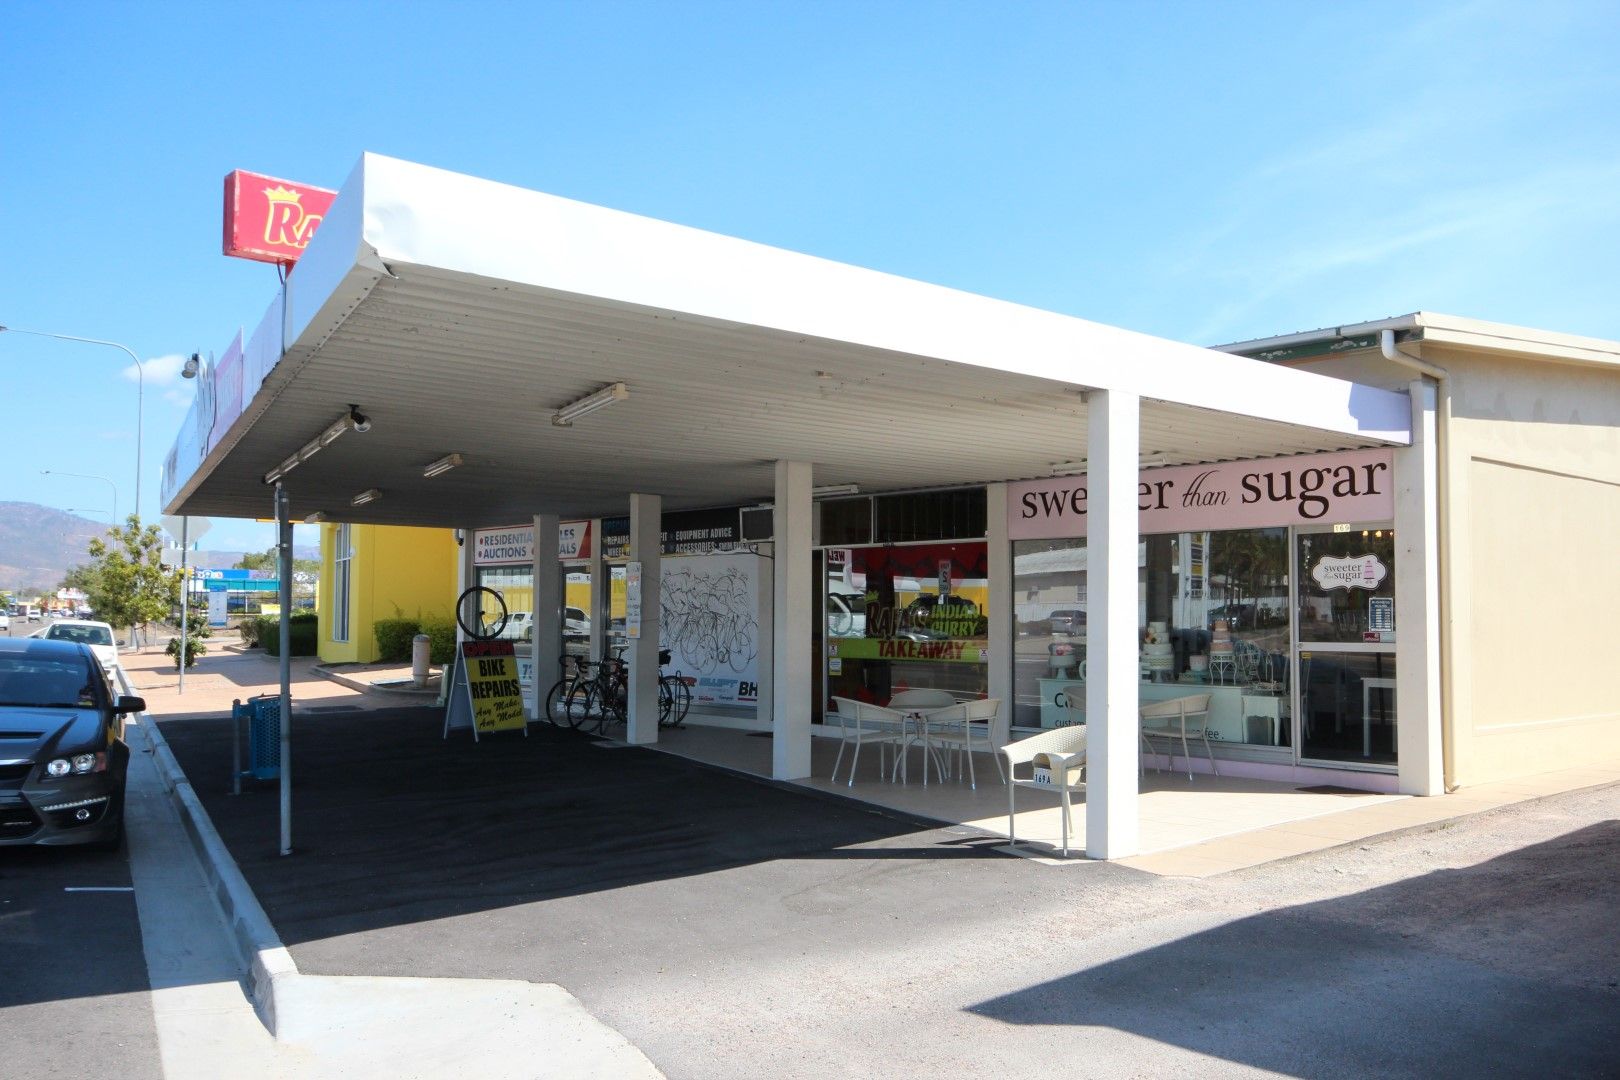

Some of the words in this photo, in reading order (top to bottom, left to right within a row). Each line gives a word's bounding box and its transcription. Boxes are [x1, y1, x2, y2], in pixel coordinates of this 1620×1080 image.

[1022, 481, 1173, 520] sweer
[1181, 470, 1230, 508] than
[1241, 463, 1387, 519] sugar
[484, 533, 534, 546] RESIDENTIA
[676, 529, 709, 541] EQUIPMENT
[711, 527, 732, 538] ADVICE
[483, 546, 527, 559] AUCTIONS
[1324, 564, 1362, 573] sweeter
[1334, 572, 1363, 583] sugar
[932, 604, 979, 618] INDIAN
[931, 621, 979, 636] CURRY
[878, 641, 965, 659] TAKEAWAY
[479, 659, 506, 676] BIKE
[471, 680, 520, 699] REPAIRS
